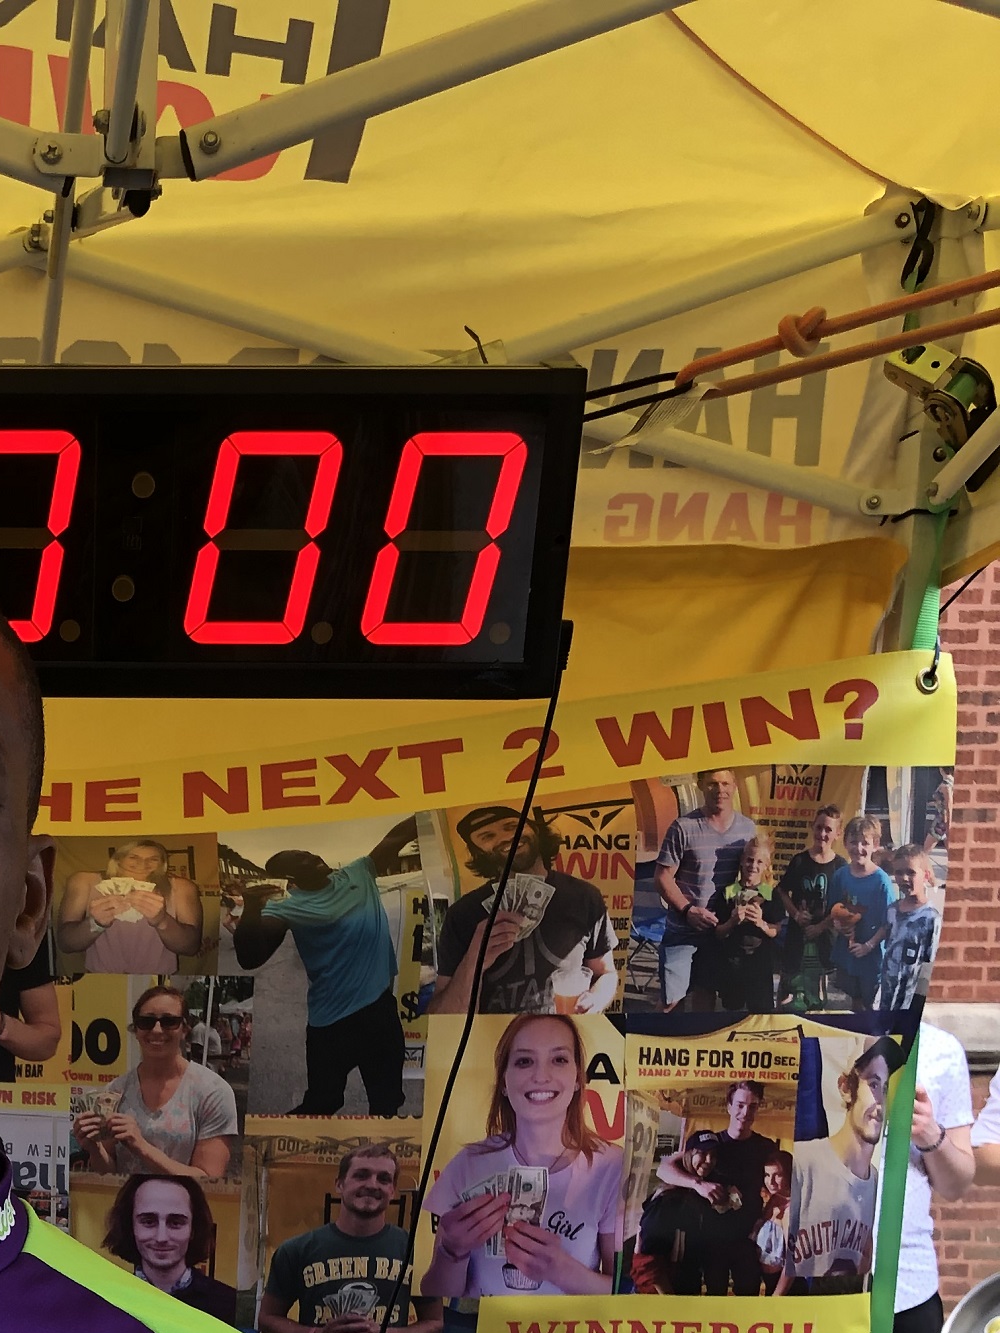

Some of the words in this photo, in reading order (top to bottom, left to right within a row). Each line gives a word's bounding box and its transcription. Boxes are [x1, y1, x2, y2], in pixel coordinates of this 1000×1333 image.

[39, 777, 143, 823] HE
[182, 738, 464, 819] NEXT
[502, 726, 566, 784] 2
[595, 678, 880, 768] WIN?
[25, 1064, 43, 1078] BAR
[638, 1046, 690, 1067] HANG
[696, 1049, 734, 1068] FOR
[741, 1051, 773, 1069] 100
[774, 1055, 799, 1067] SEC.
[638, 1068, 671, 1077] HANG
[675, 1069, 689, 1077] AT
[693, 1069, 725, 1078] YOUR
[729, 1071, 755, 1079] OWN
[758, 1071, 786, 1081] RISK
[22, 1091, 56, 1106] RISK
[548, 1210, 585, 1241] Girl
[788, 1220, 840, 1264] SOUTH
[303, 1256, 370, 1288] GREEN
